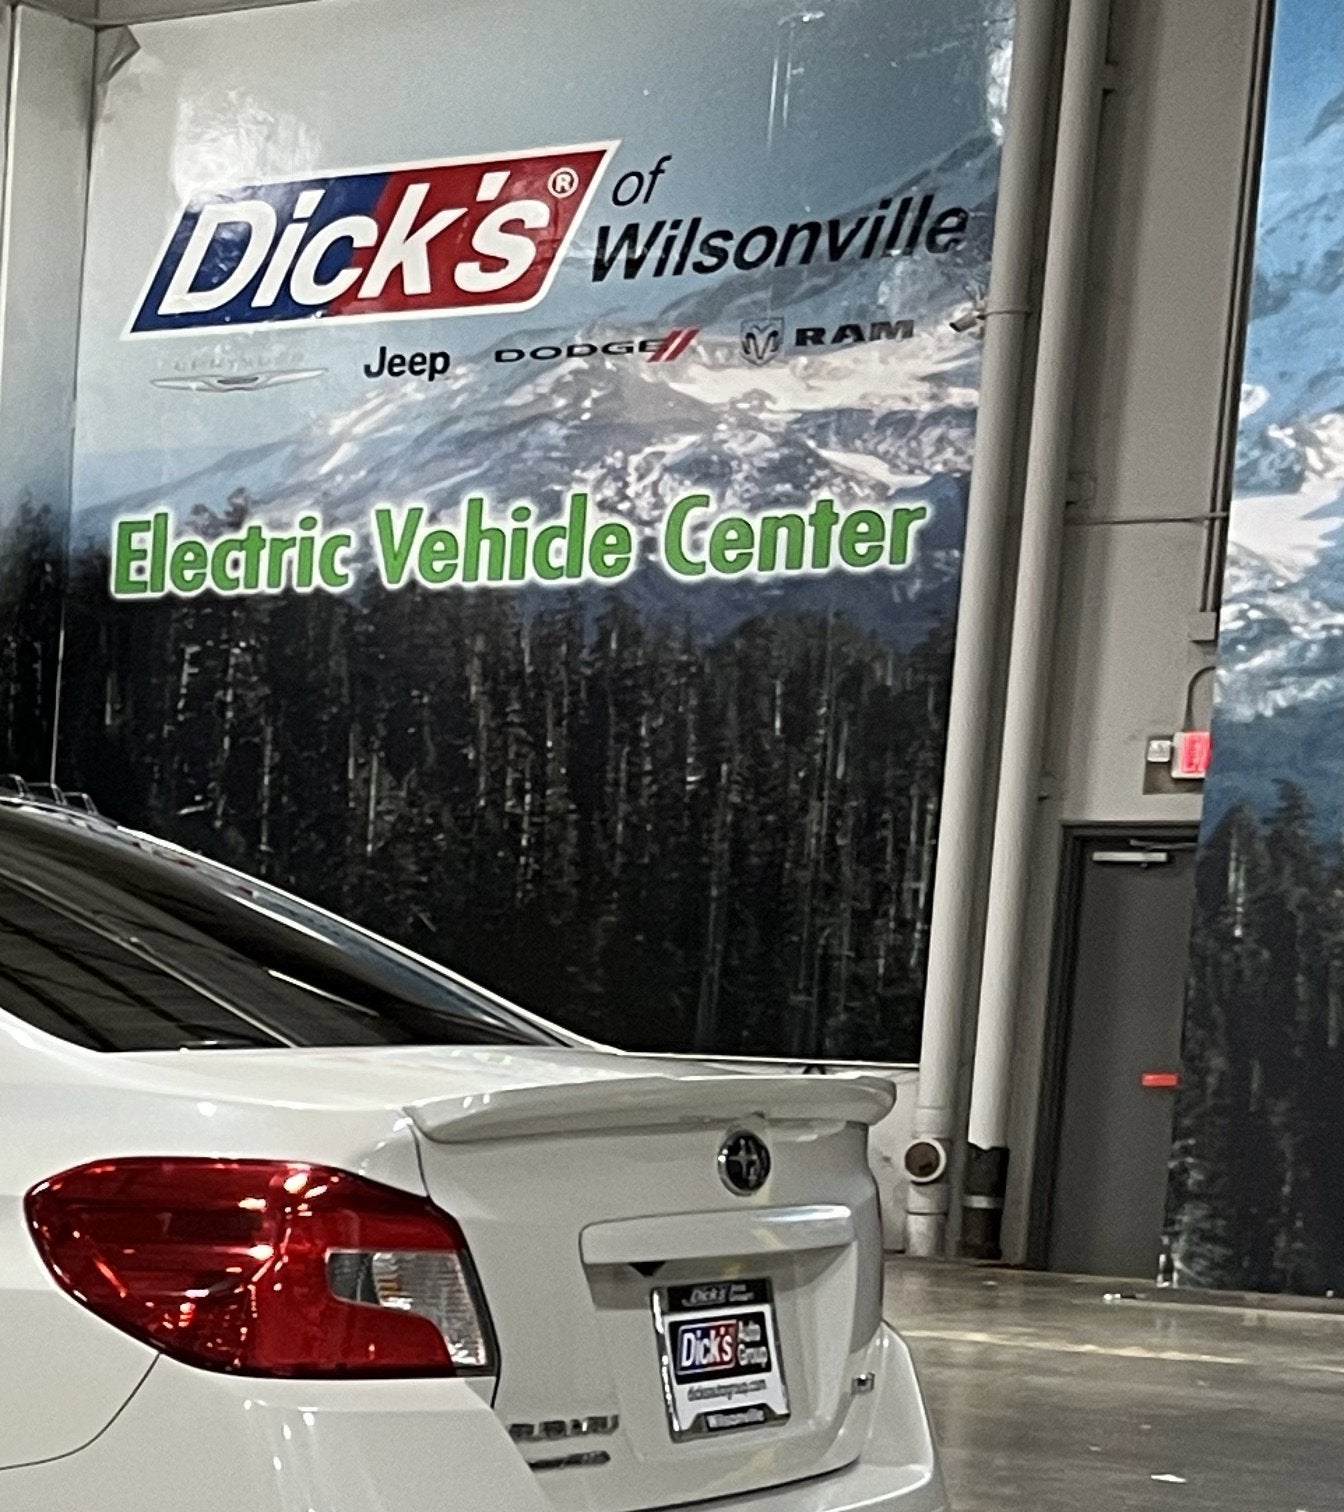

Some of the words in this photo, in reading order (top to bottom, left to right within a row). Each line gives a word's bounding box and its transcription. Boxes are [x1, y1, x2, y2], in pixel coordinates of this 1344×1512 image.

[612, 155, 672, 206] of
[158, 172, 547, 315] Dick's
[590, 194, 967, 284] Wilsonville
[494, 339, 664, 364] DODGE
[795, 319, 914, 347] RAM
[364, 346, 451, 382] Jeep
[113, 511, 352, 597] Electric
[374, 493, 633, 586] Vehicle
[663, 494, 927, 577] Center
[681, 1327, 733, 1367] Dick's
